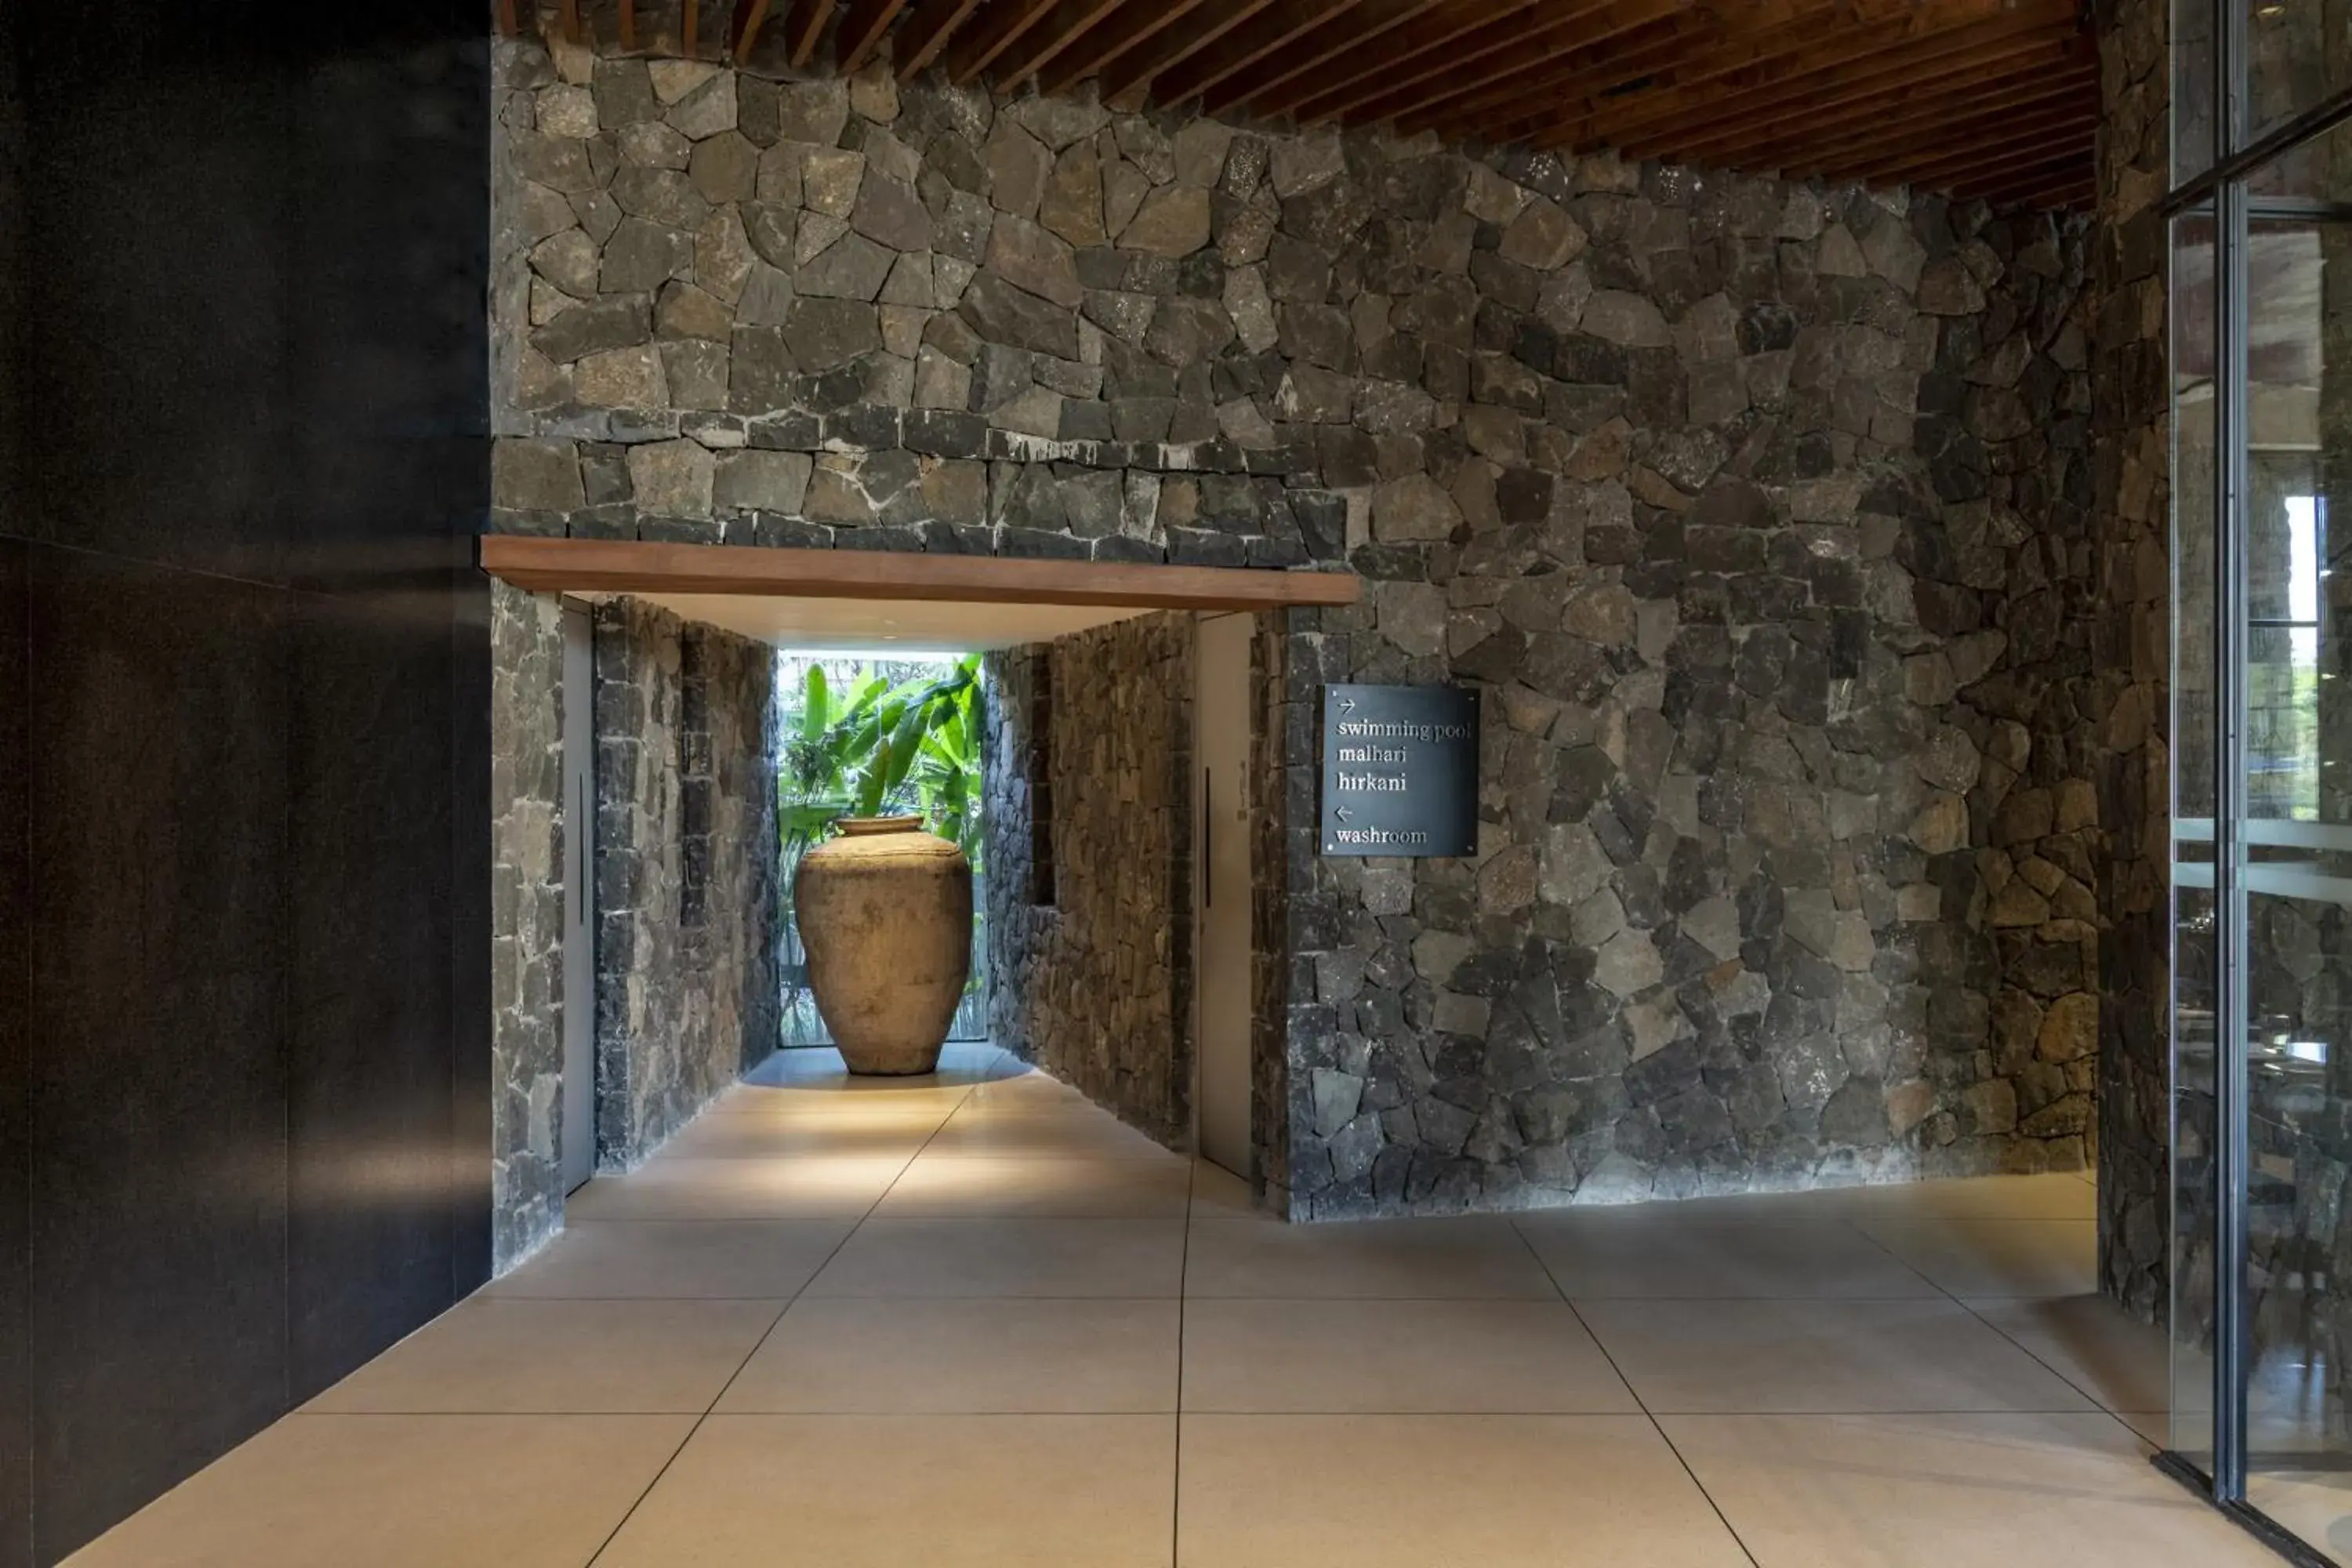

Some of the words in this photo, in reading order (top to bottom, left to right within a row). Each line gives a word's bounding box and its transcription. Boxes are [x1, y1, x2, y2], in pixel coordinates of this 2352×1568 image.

[1338, 718, 1430, 741] swimming
[1434, 722, 1472, 742] pool
[1338, 746, 1406, 763] malhari
[1338, 771, 1406, 791] hirkani
[1336, 826, 1427, 844] washroom
